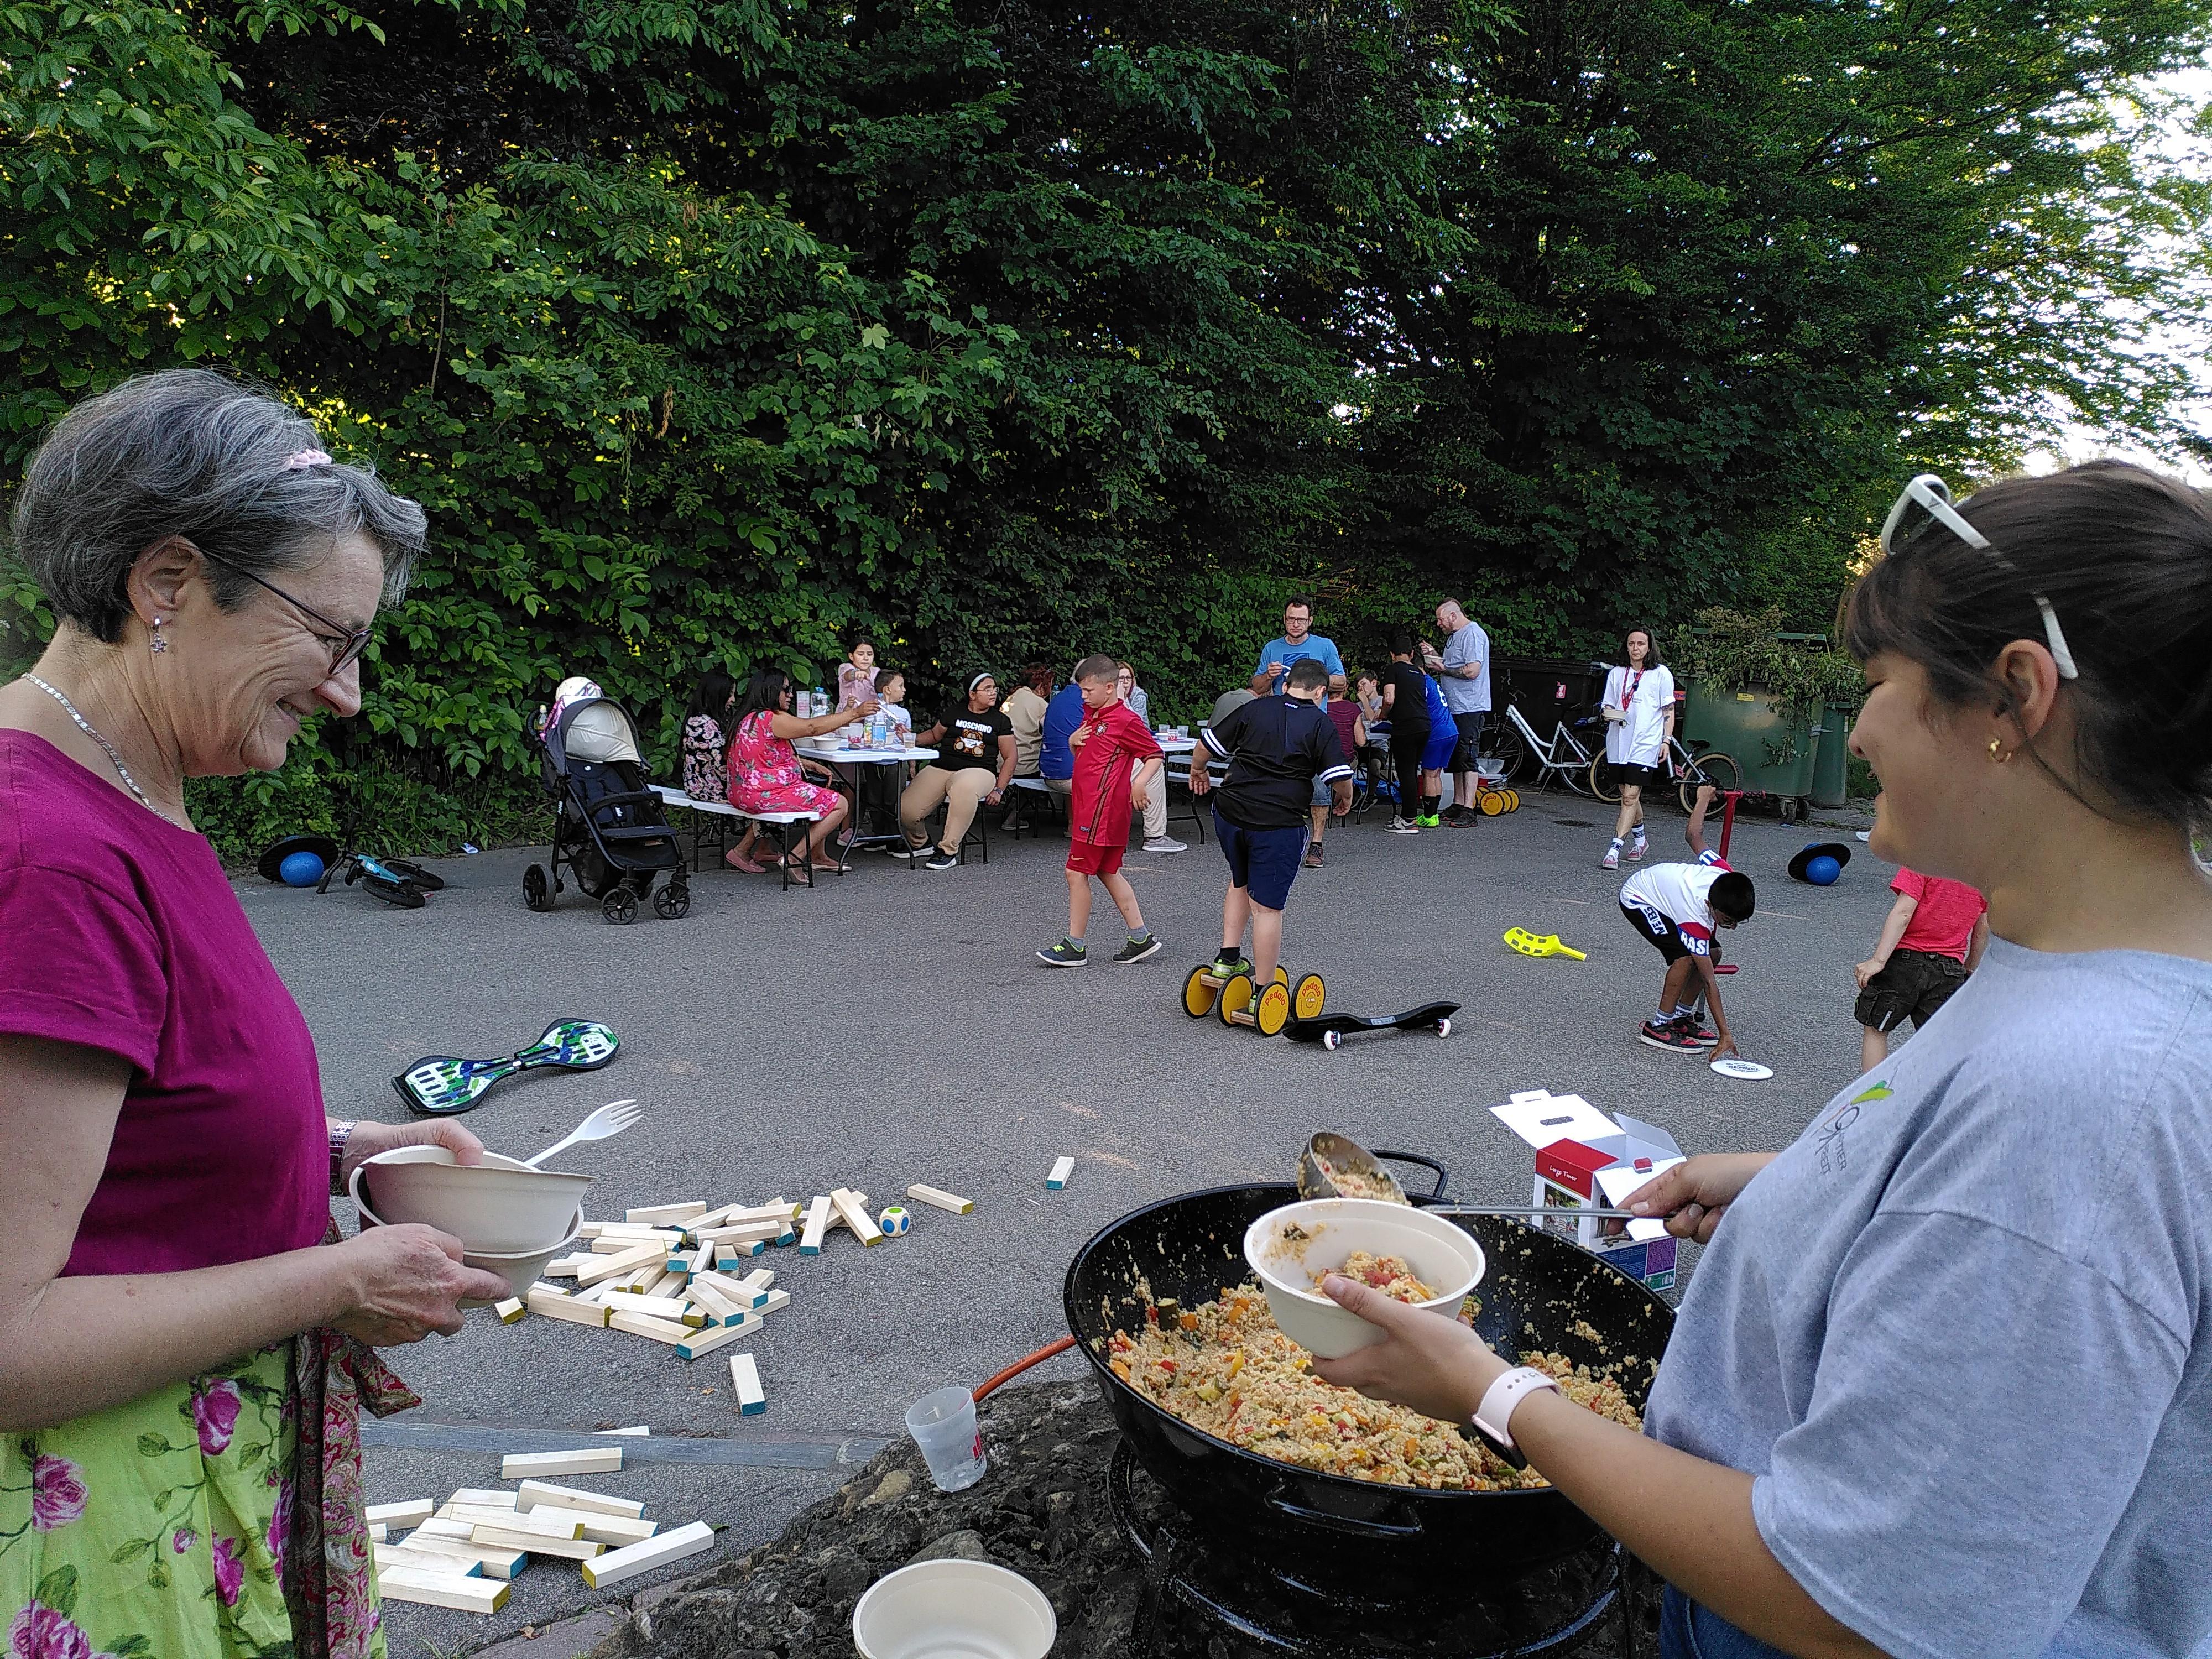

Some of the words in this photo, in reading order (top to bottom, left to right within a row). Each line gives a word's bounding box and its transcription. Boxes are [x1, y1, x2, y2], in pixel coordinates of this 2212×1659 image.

[955, 719, 992, 734] MOSCHINO
[1301, 981, 1321, 997] pedalo
[1264, 989, 1286, 1006] pedalo
[1550, 1164, 1562, 1177] Large
[1563, 1171, 1578, 1181] Tower
